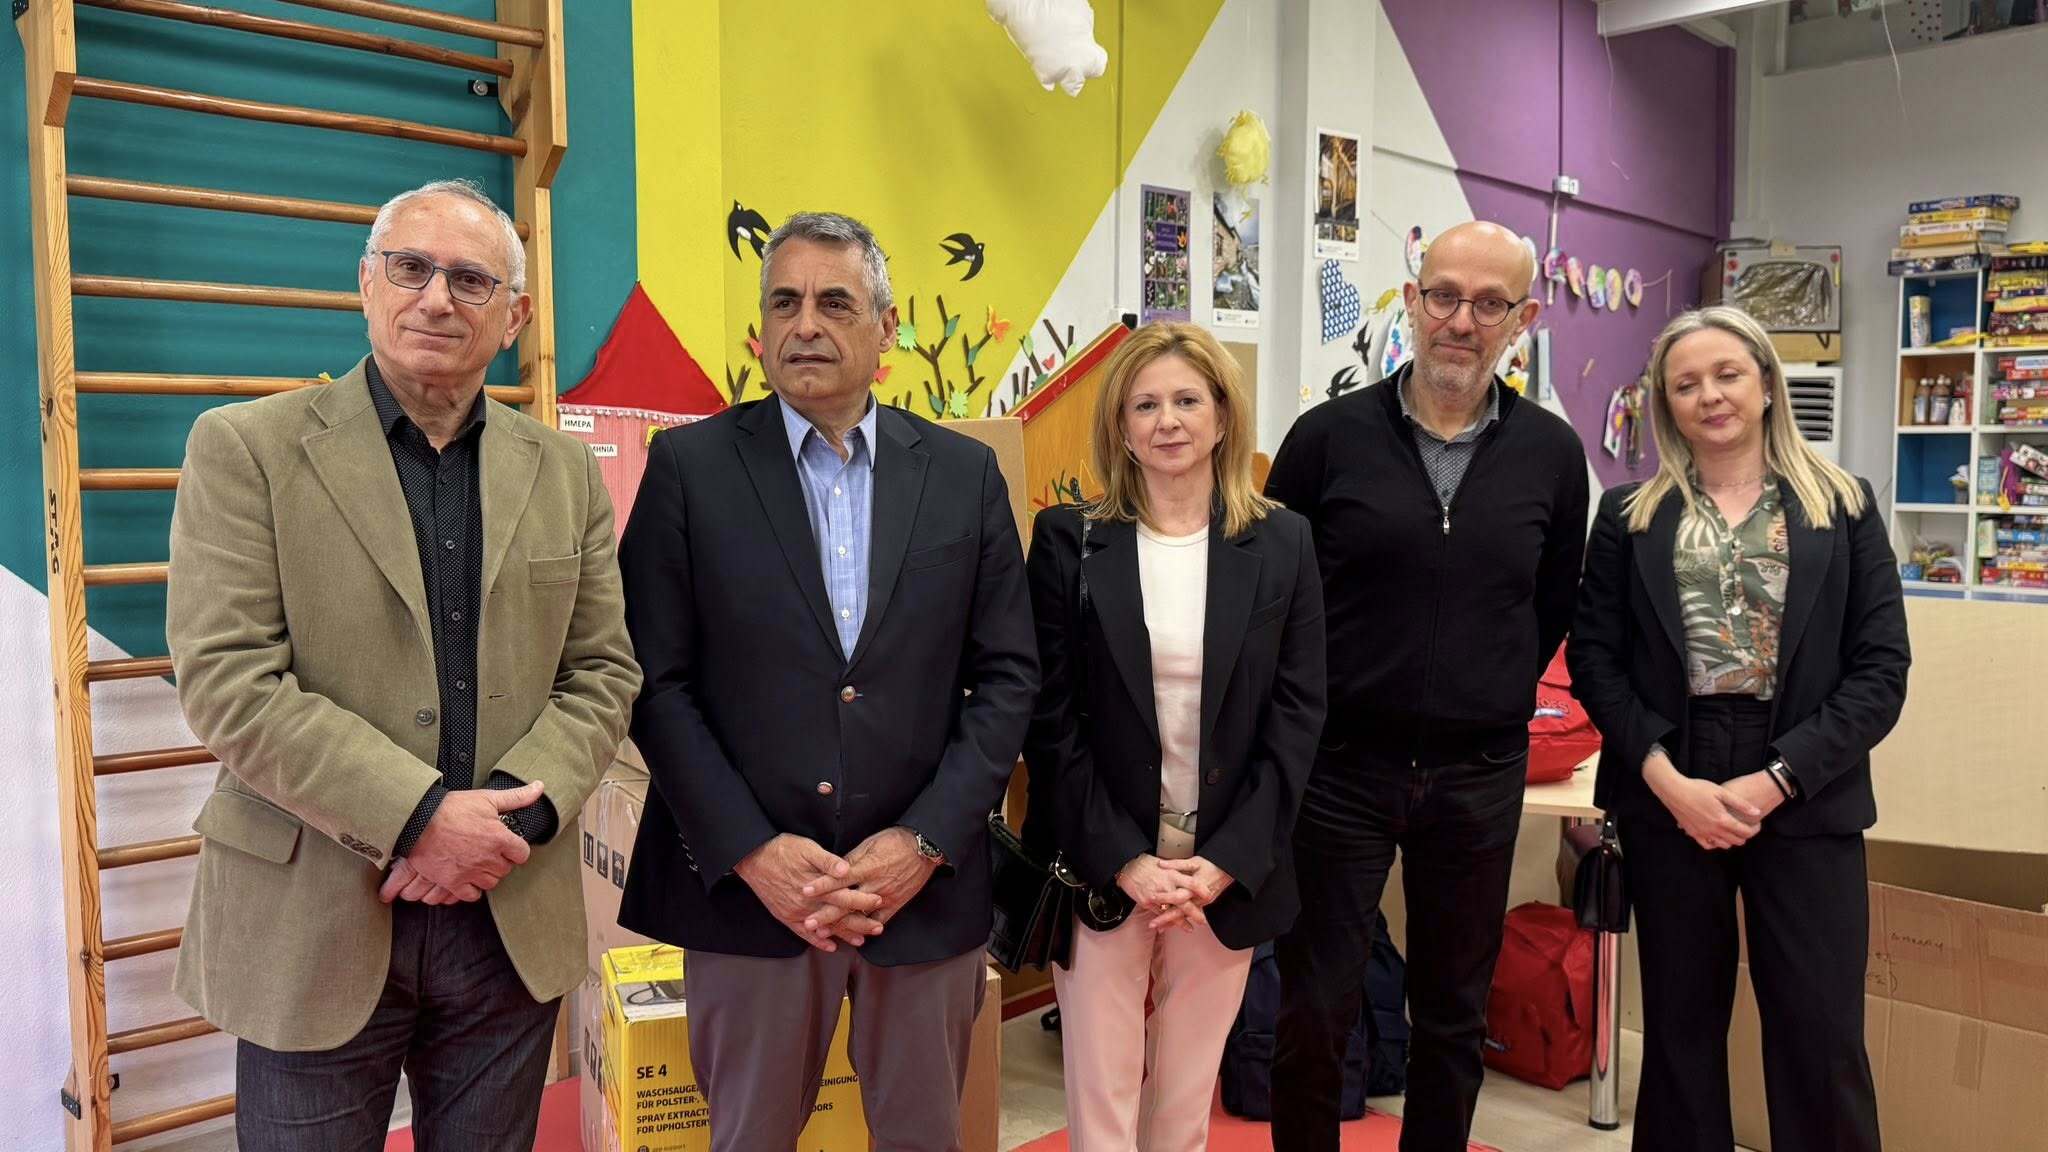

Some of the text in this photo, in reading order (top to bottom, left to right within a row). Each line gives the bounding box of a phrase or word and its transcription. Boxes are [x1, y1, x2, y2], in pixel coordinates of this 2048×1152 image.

[565, 419, 591, 428] ΗΜΕΡΑ
[637, 1064, 667, 1080] SE 4
[636, 1084, 698, 1099] WASCHSAUGE
[637, 1099, 654, 1110] FÜR
[820, 1076, 858, 1086] EINIGUNG
[636, 1107, 709, 1124] SPRAY EXTRACTI
[637, 1126, 654, 1134] FOR
